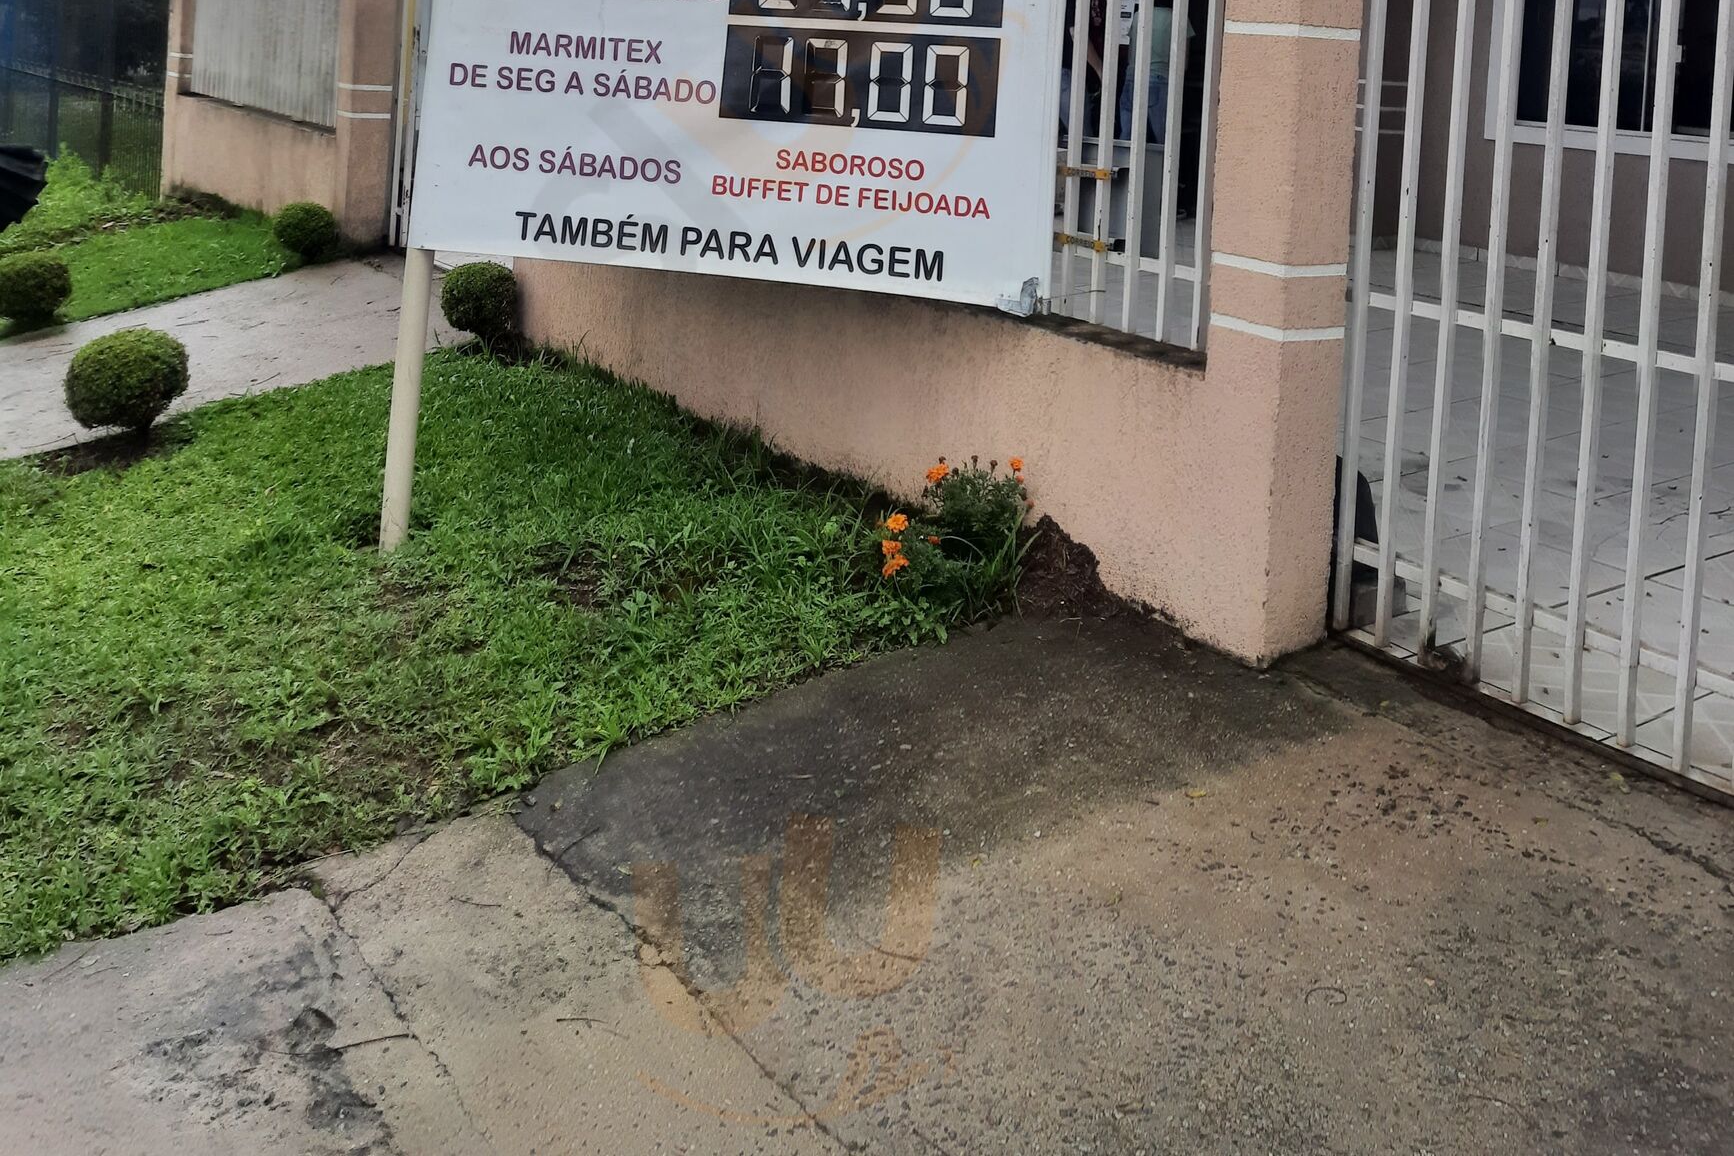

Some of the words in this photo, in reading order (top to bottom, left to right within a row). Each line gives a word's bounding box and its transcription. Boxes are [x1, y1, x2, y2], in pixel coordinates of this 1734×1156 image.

[509, 30, 663, 65] MARMITEX
[449, 62, 489, 89] DE
[496, 65, 556, 94] SEG
[563, 70, 585, 96] A
[592, 68, 718, 105] SÁBADO
[778, 35, 971, 128] 17,00
[467, 143, 530, 172] AOS
[538, 145, 682, 185] SÁBADOS
[775, 148, 925, 182] SABOROSO
[711, 174, 809, 203] BUFFET
[815, 183, 851, 207] DE
[857, 187, 991, 220] FEIJOADA
[514, 210, 669, 255] TAMBÉM
[679, 226, 779, 266] PARA
[791, 235, 945, 282] VIAGEM
